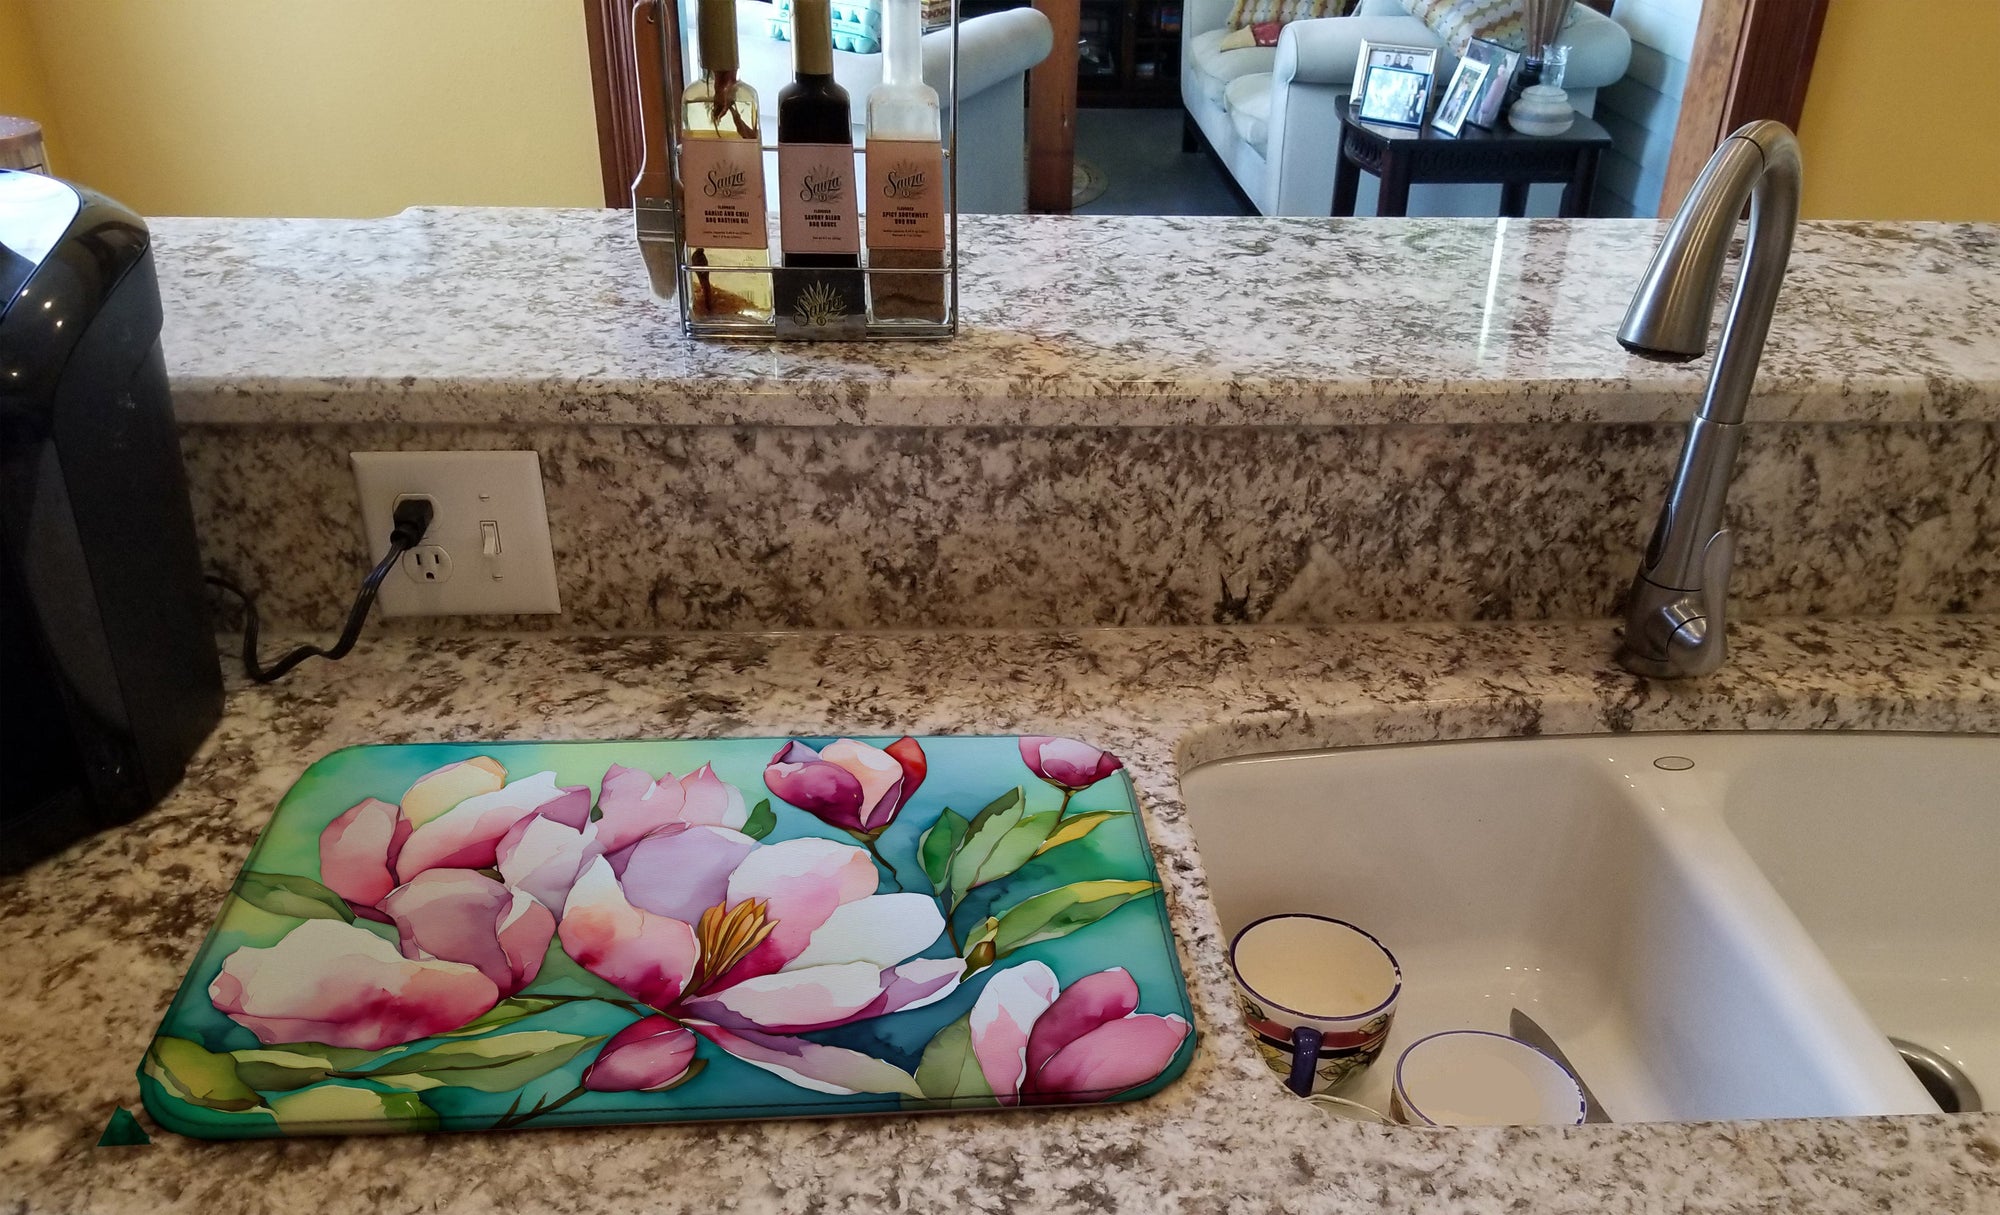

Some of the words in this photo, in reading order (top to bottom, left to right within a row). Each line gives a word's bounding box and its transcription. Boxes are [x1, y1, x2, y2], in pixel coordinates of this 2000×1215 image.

[704, 170, 745, 197] Sauza
[800, 175, 841, 202] Sauza
[884, 171, 925, 198] Sauza
[793, 294, 843, 327] Sauza
